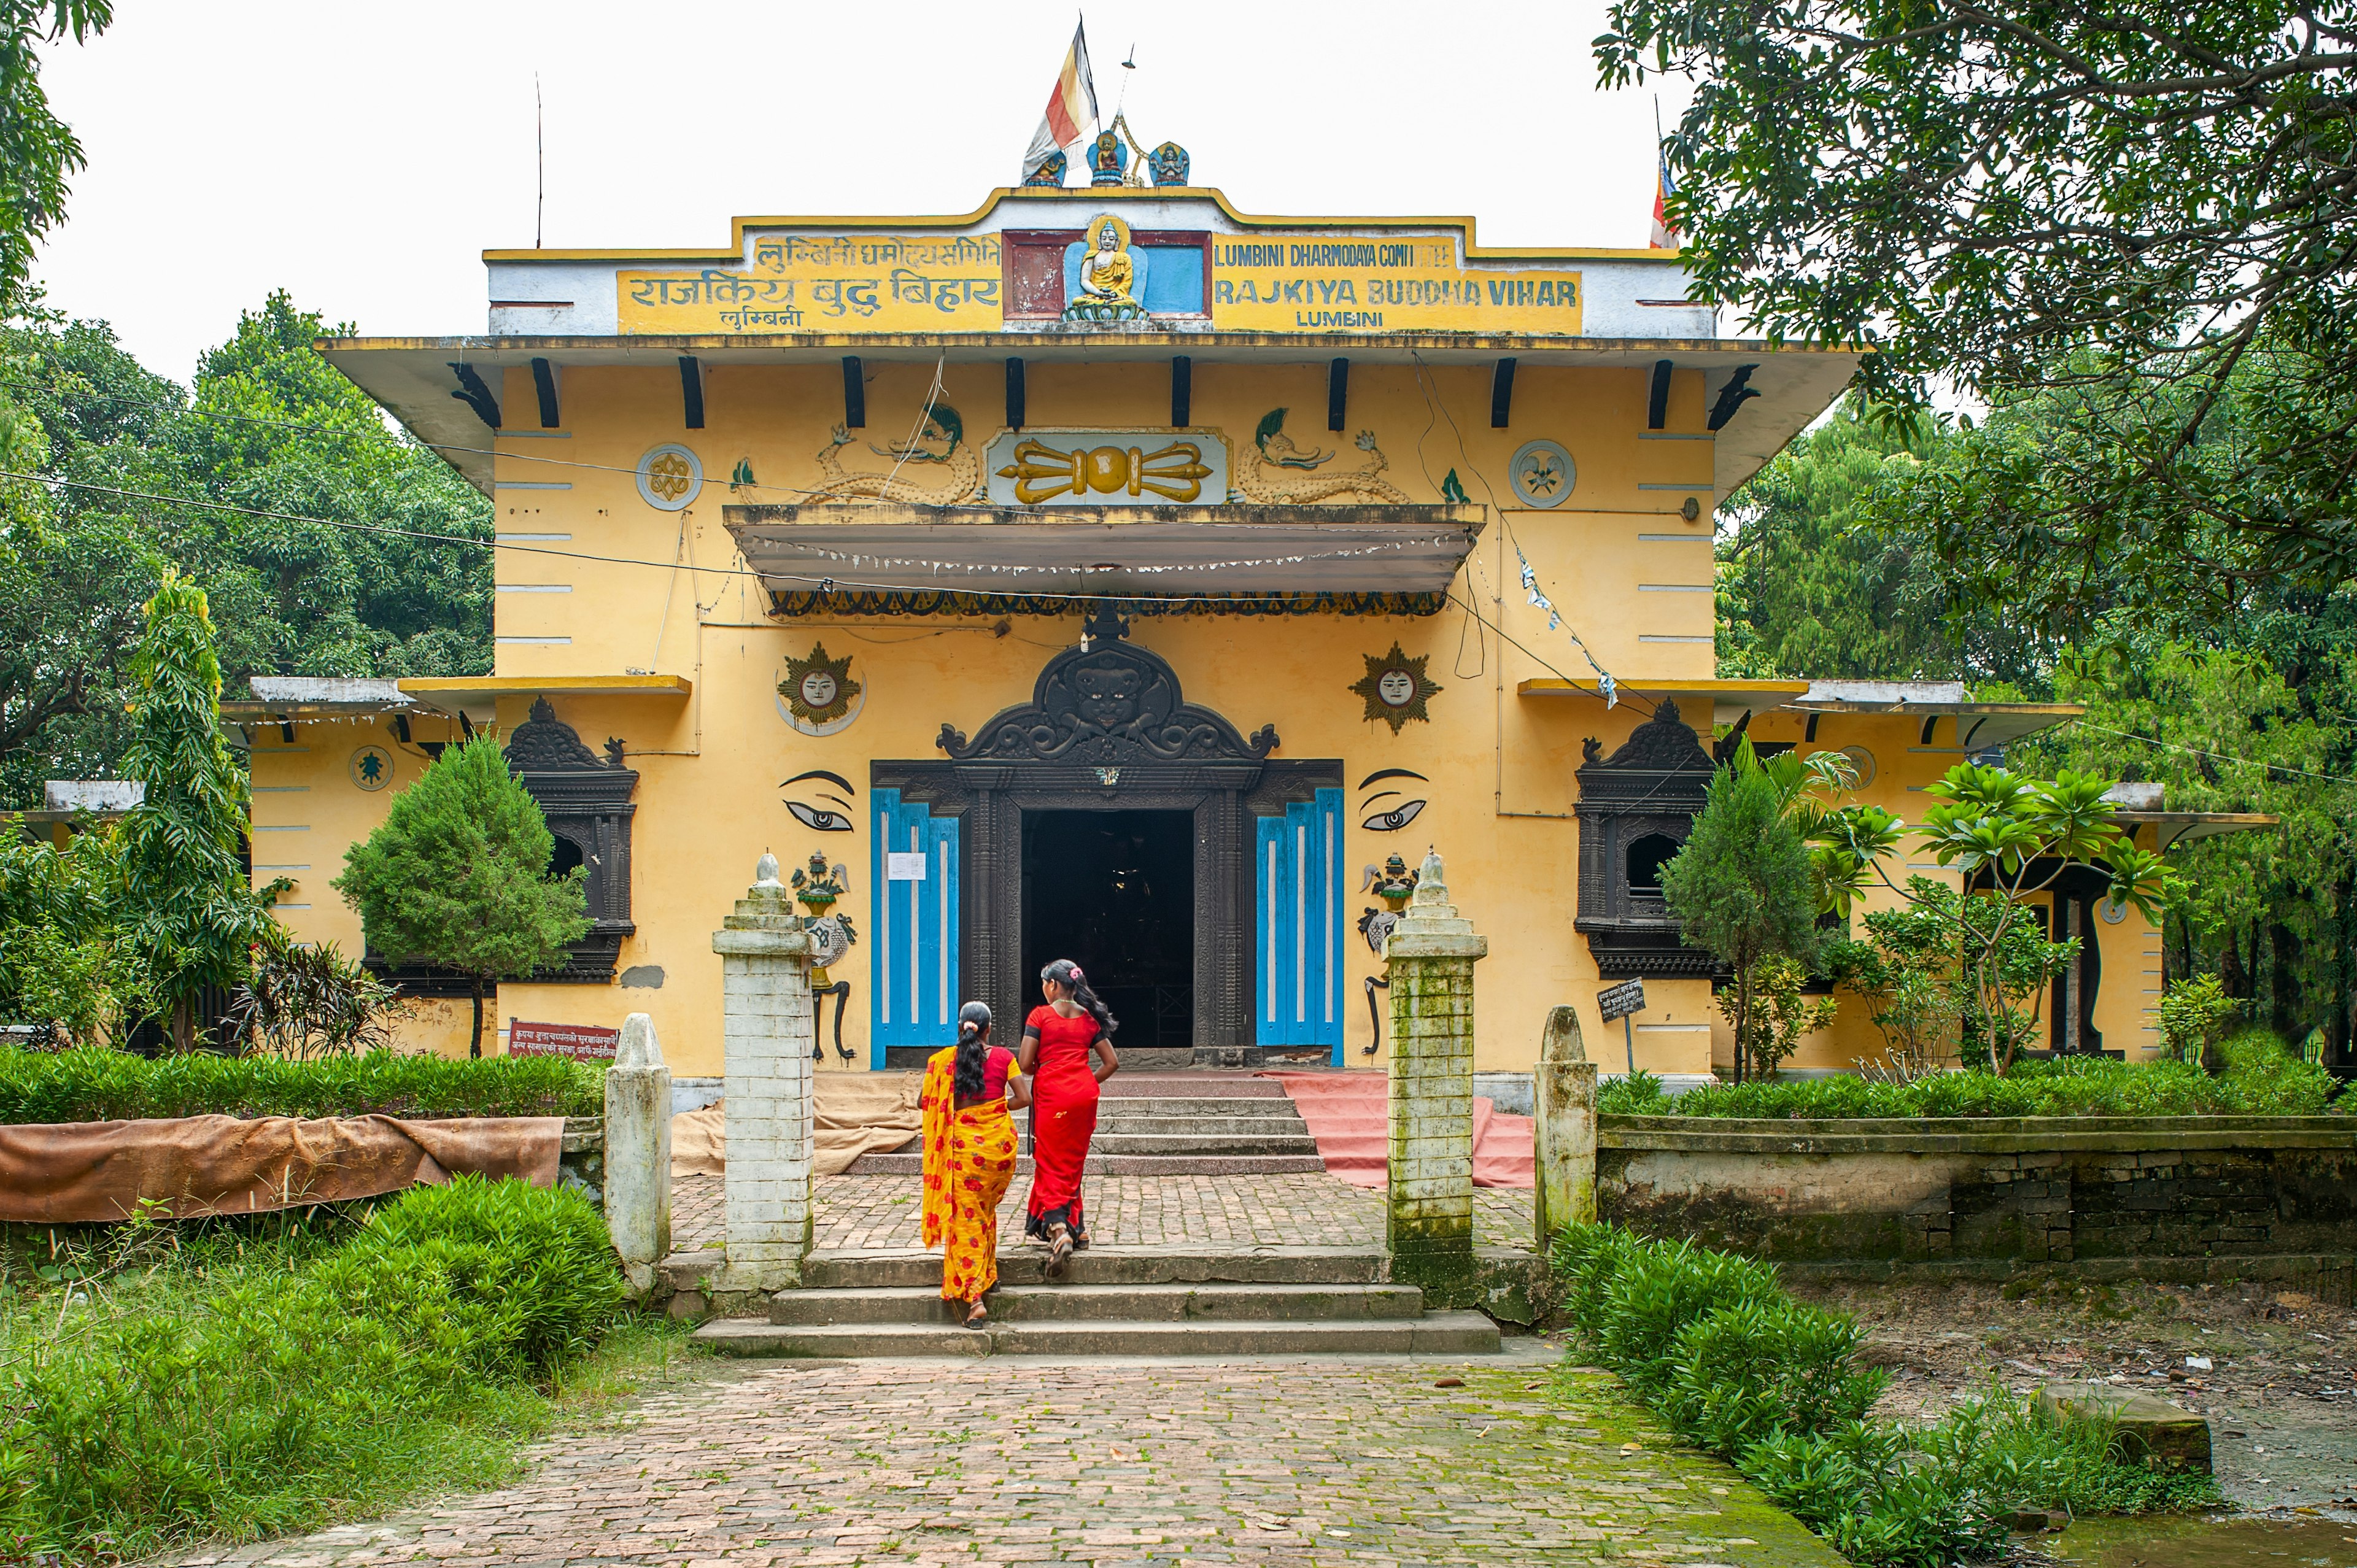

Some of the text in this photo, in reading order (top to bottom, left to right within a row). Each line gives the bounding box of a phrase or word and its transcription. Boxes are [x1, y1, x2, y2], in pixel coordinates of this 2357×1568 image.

[758, 236, 856, 274] लुम्बिनी
[1214, 244, 1284, 268] LUMBINI
[1290, 244, 1376, 268] DHARMODAYA
[630, 268, 1001, 317] राजकिय बुद्ध बिहार
[1215, 279, 1576, 308] RAJKIYA BUDDHA VIHAR
[719, 305, 805, 330] लुम्बिनी
[1296, 311, 1384, 329] LUMBINI
[516, 1030, 534, 1040] कृपया
